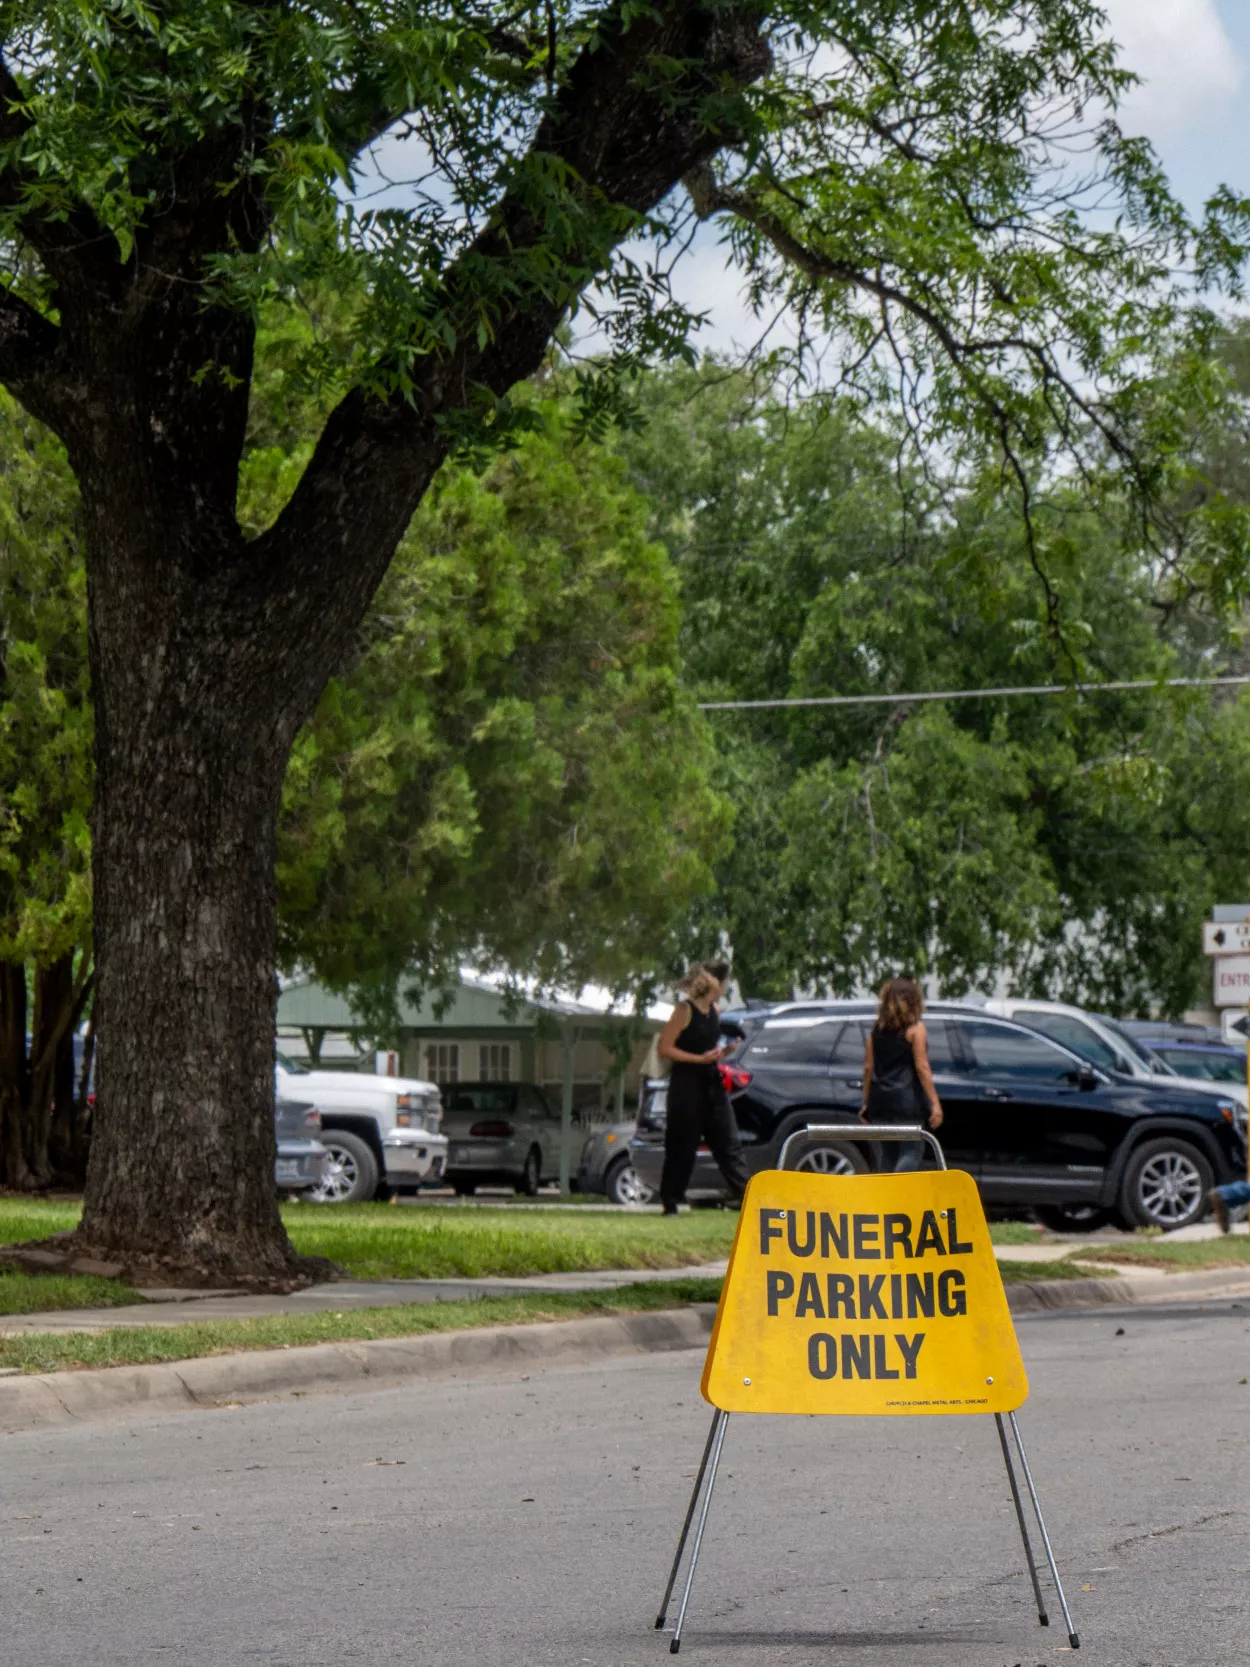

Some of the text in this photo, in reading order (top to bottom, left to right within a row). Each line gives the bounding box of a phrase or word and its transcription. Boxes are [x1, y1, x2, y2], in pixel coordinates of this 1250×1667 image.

[759, 1207, 973, 1260] FUNERAL
[767, 1269, 968, 1319] PARKING
[807, 1332, 926, 1380] ONLY
